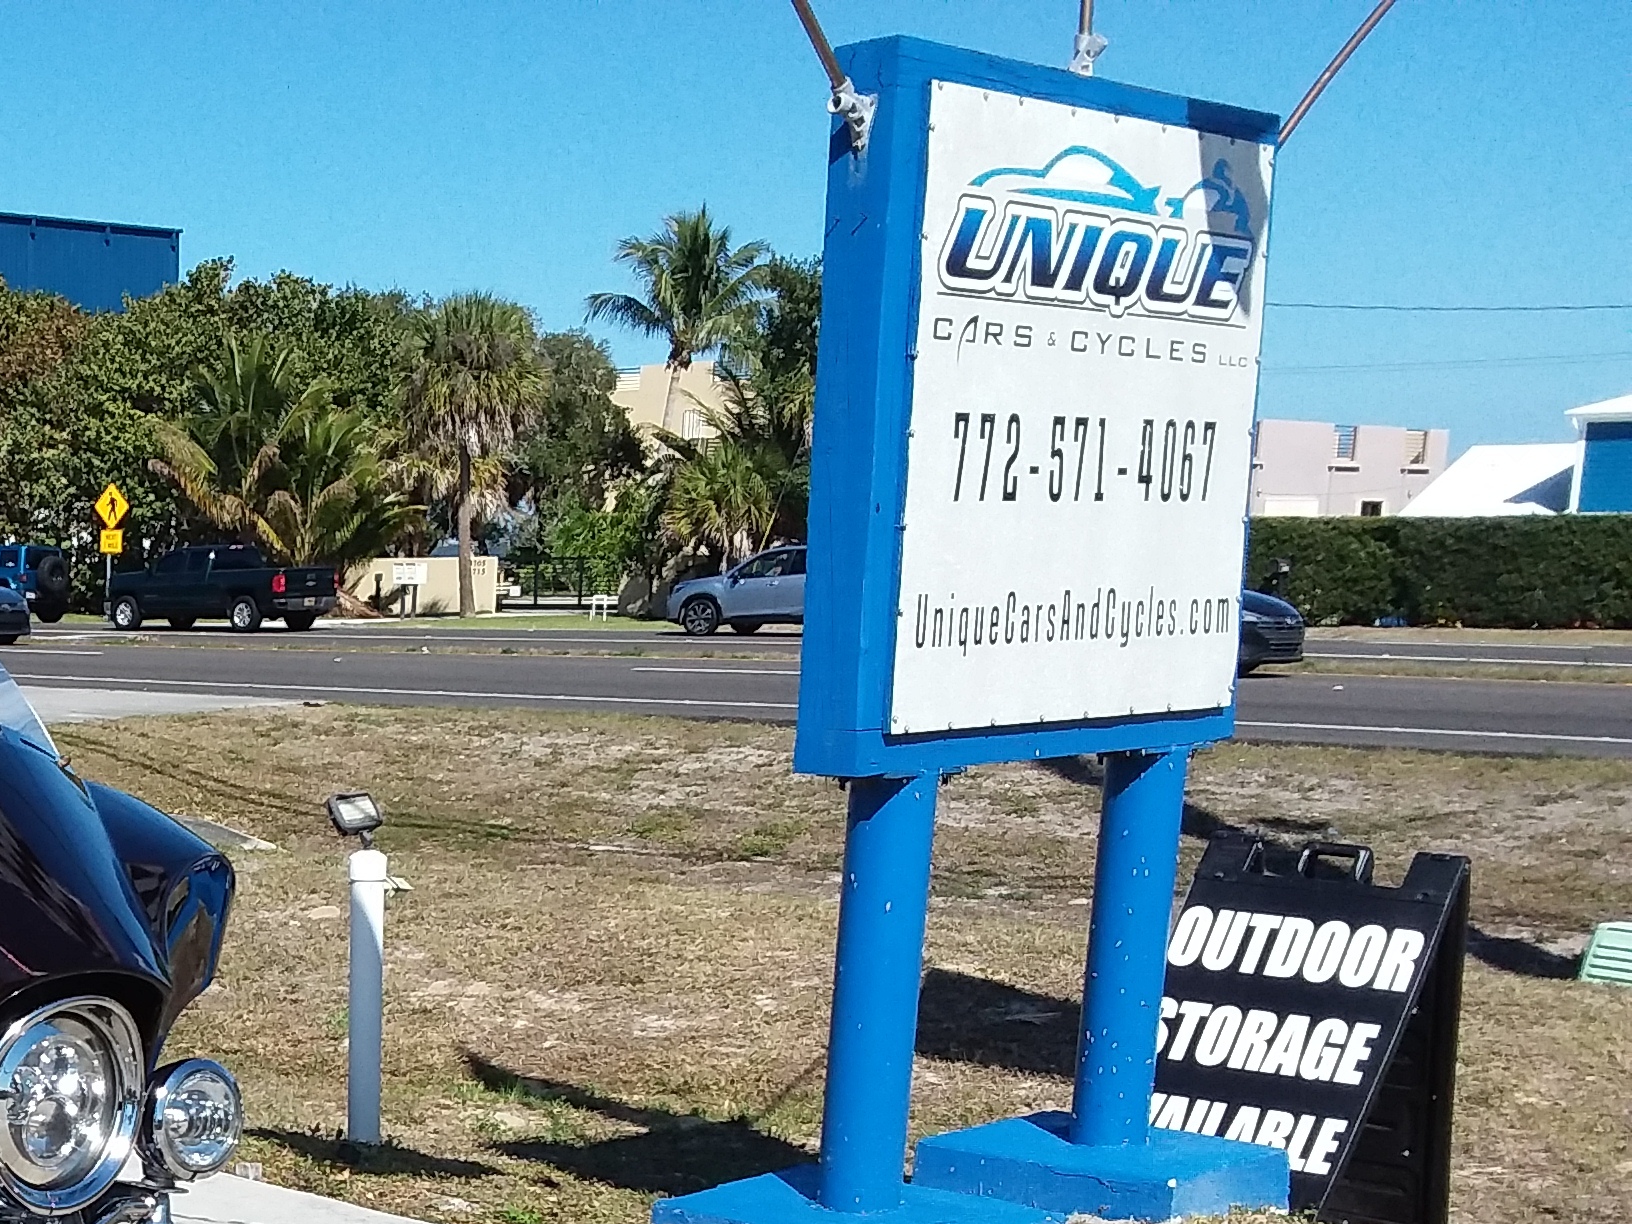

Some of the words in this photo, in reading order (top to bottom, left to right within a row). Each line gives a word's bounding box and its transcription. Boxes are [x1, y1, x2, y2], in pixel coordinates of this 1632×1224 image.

[941, 200, 1251, 314] UNIQUE
[933, 314, 1033, 366] CARS
[1047, 331, 1057, 347] &
[1070, 330, 1207, 364] CYCLES
[1218, 354, 1248, 368] LLC
[953, 411, 1217, 502] 772-571-4067
[915, 586, 1229, 657] UniqueCarsAndCycles.com
[1167, 904, 1425, 993] OUTDOOR
[1156, 996, 1381, 1086] STORAGE
